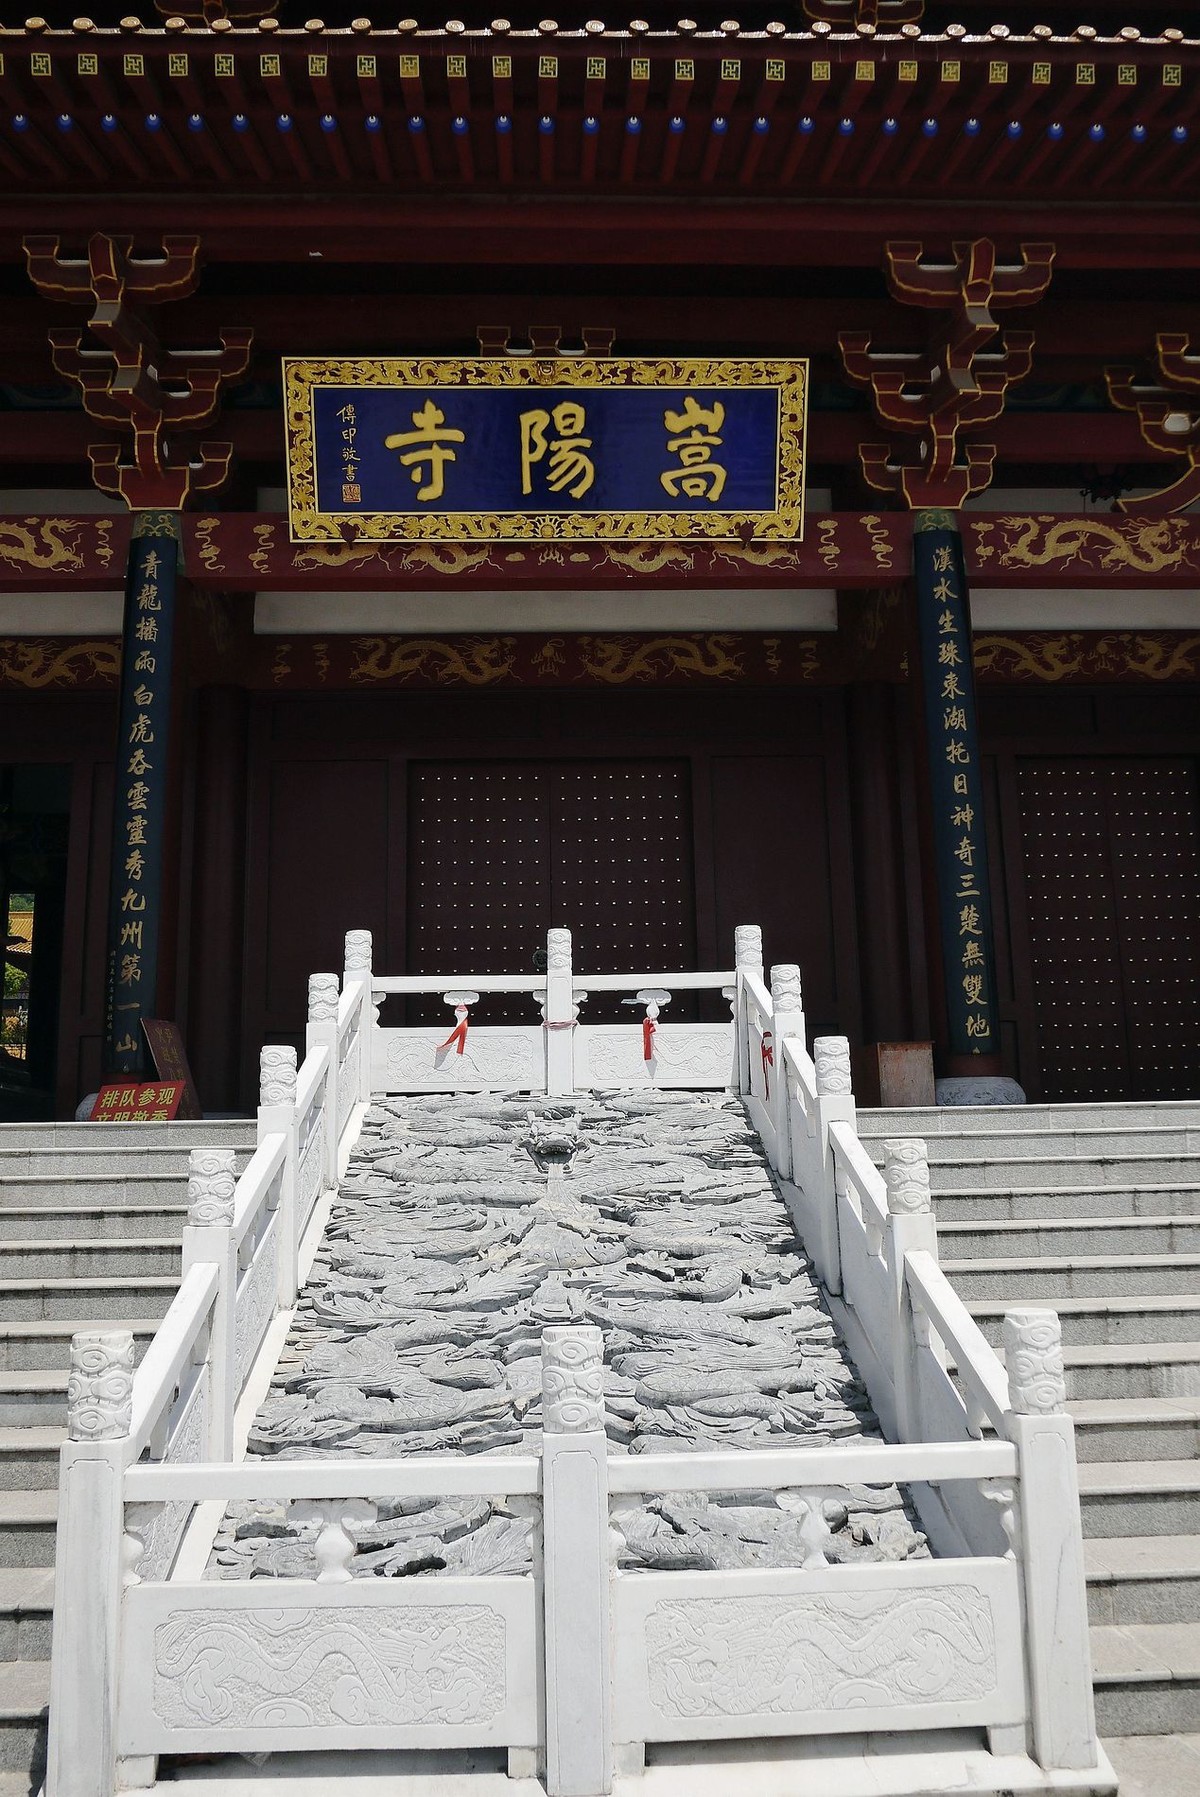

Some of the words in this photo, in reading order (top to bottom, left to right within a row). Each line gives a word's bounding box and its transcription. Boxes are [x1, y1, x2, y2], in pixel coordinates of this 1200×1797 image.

[384, 396, 727, 502] 嵩陽寺
[100, 1087, 176, 1108] 排队参观
